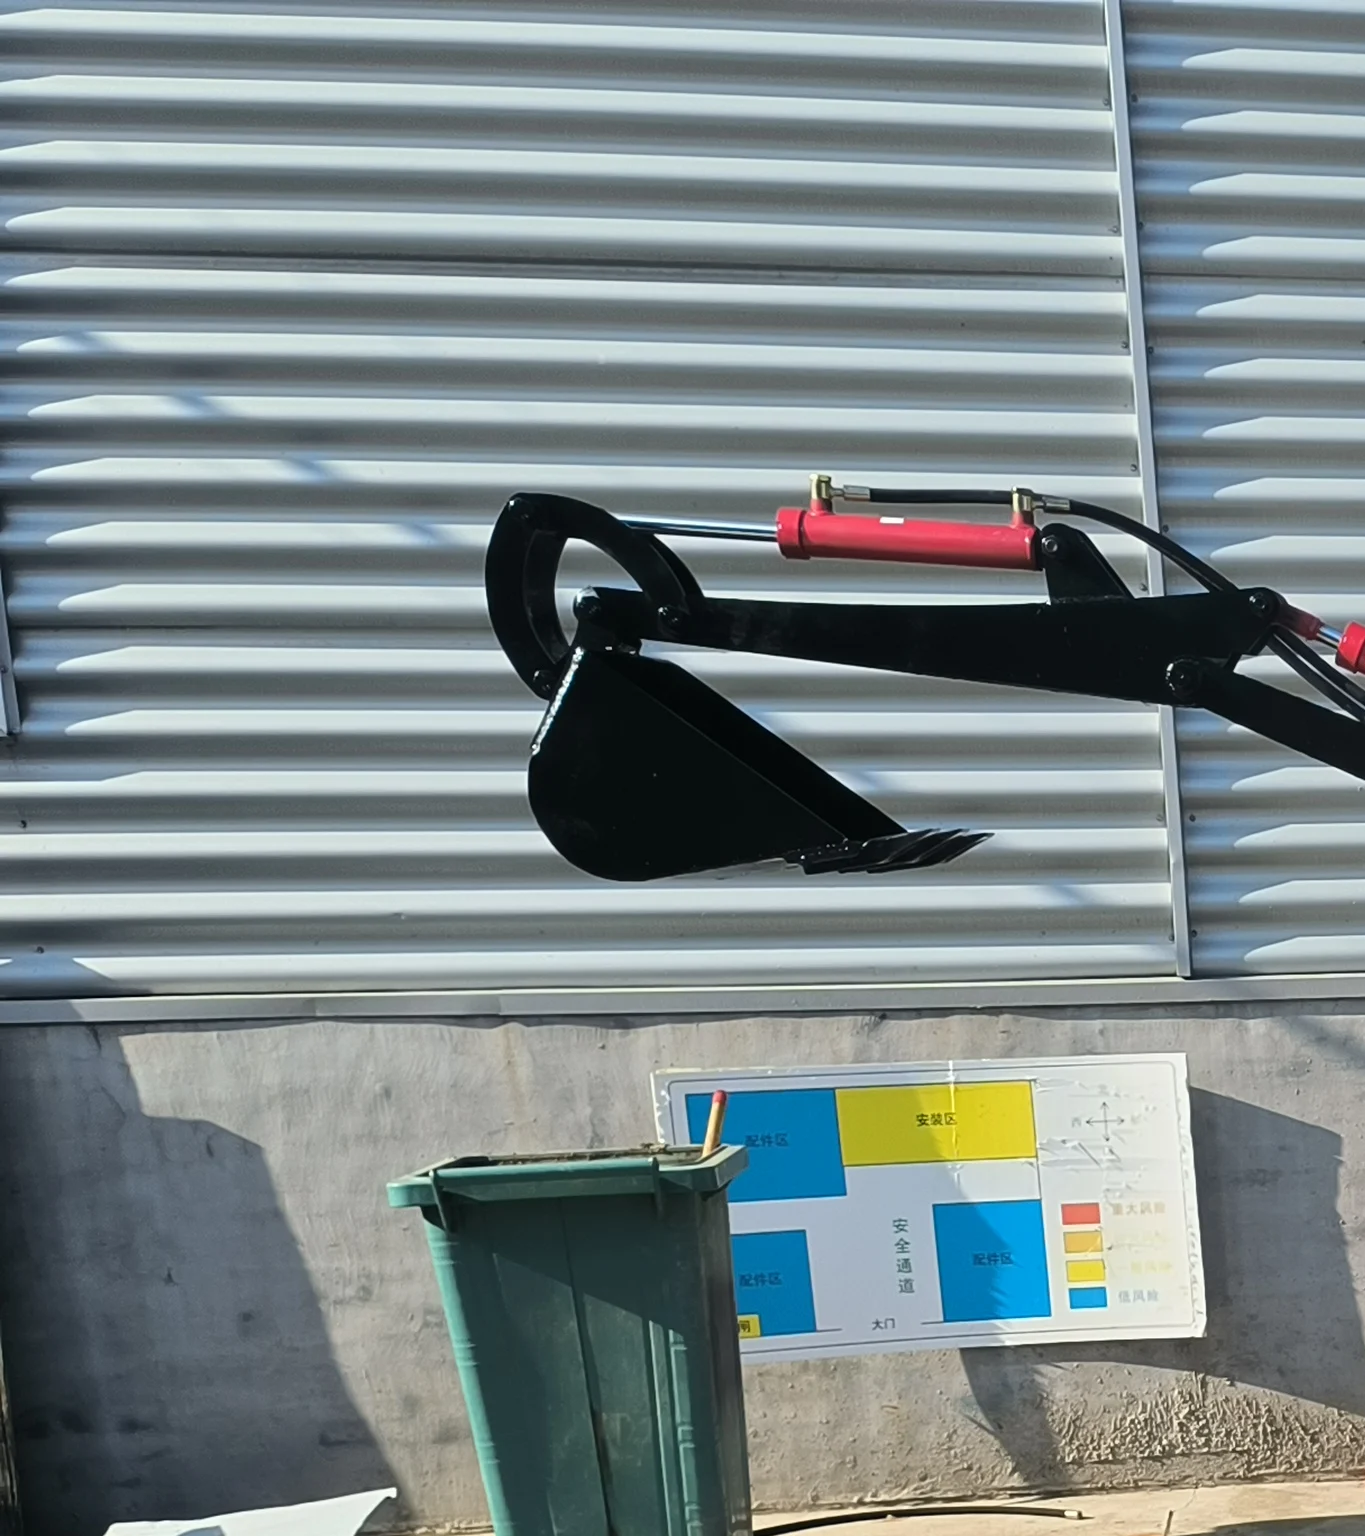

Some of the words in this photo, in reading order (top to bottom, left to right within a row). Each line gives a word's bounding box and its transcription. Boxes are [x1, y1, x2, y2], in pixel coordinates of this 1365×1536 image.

[916, 1113, 957, 1127] 安装区
[745, 1133, 788, 1148] 配件区
[892, 1218, 915, 1294] 安全通道
[972, 1252, 1014, 1266] 配件区
[739, 1272, 782, 1287] 配件区
[1118, 1289, 1159, 1303] 低风险
[872, 1318, 895, 1331] 大门
